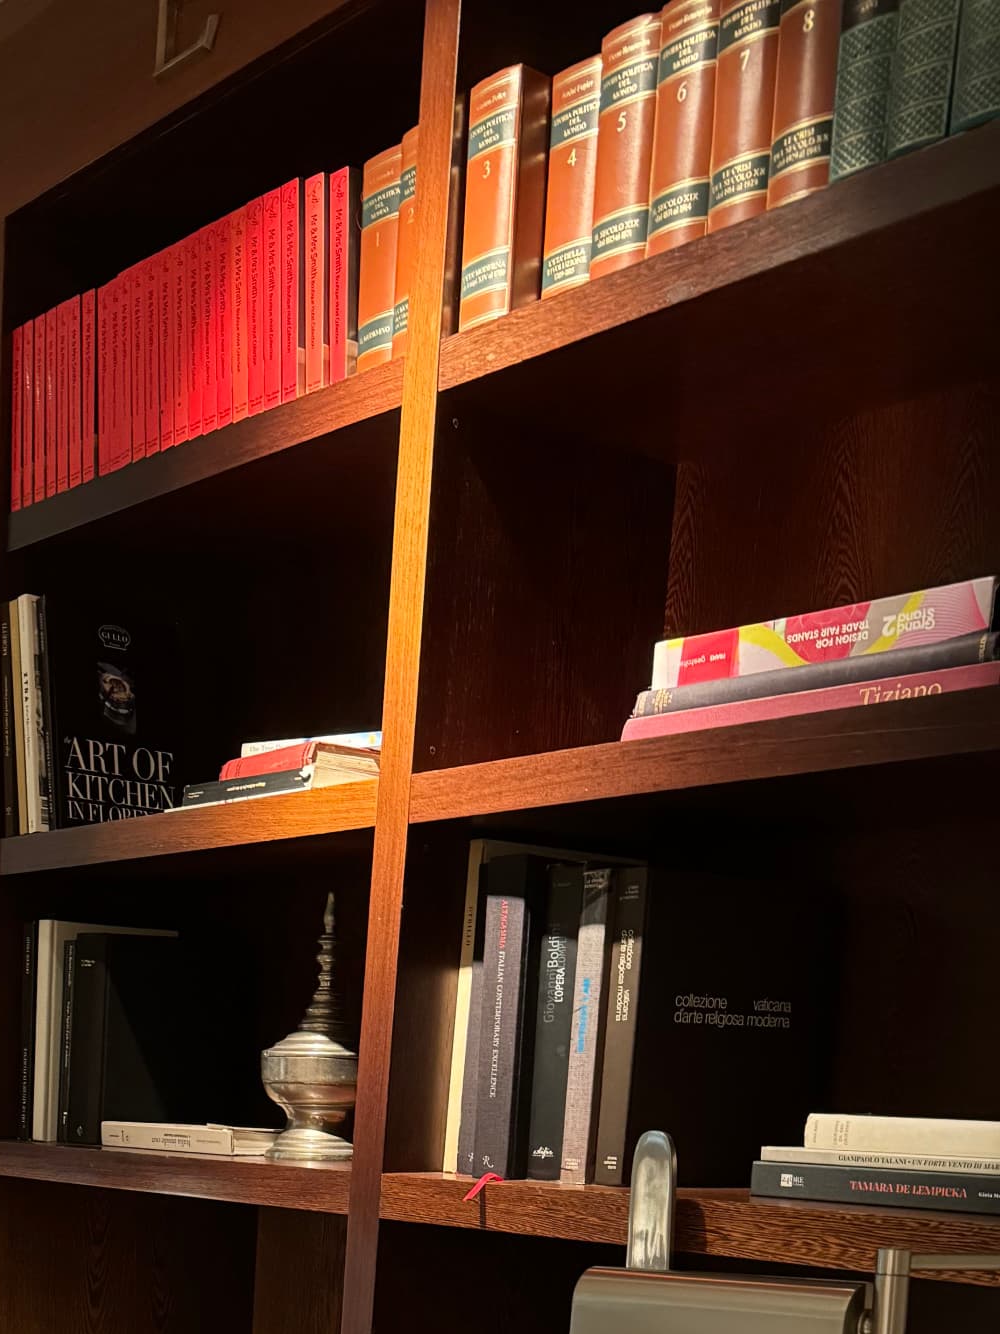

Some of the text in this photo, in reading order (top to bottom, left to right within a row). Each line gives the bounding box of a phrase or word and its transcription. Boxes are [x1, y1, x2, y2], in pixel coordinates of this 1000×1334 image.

[803, 9, 815, 32] 8
[740, 49, 750, 71] 7
[677, 81, 688, 103] 6
[617, 112, 627, 132] 5
[567, 149, 577, 166] 4
[482, 160, 491, 178] 3
[408, 208, 415, 223] 2
[375, 232, 380, 247] 1
[897, 607, 935, 622] Stand
[786, 619, 869, 644] TRADE FAIR STANDS
[882, 615, 896, 636] 2
[897, 616, 935, 637] Grand
[816, 630, 868, 649] DESIGN FOR
[860, 681, 942, 706] Tiziano
[65, 737, 173, 783] ART OF
[66, 771, 176, 810] KITCHEN
[68, 800, 85, 821] IN
[497, 950, 506, 982] ITALIAN
[554, 967, 565, 1003] L'OPERA
[675, 993, 792, 1013] collezione vaticana
[493, 984, 503, 1047] CONTEMPORARY
[674, 1009, 703, 1025] d'arte
[746, 1014, 790, 1029] moderna
[489, 1049, 498, 1099] EXCELLENCE
[838, 1155, 880, 1165] GIAMPAOLO
[881, 1157, 907, 1166] TALANI
[947, 1161, 973, 1169] VENTO
[849, 1180, 967, 1199] TAMARA DE LEMPICKA
